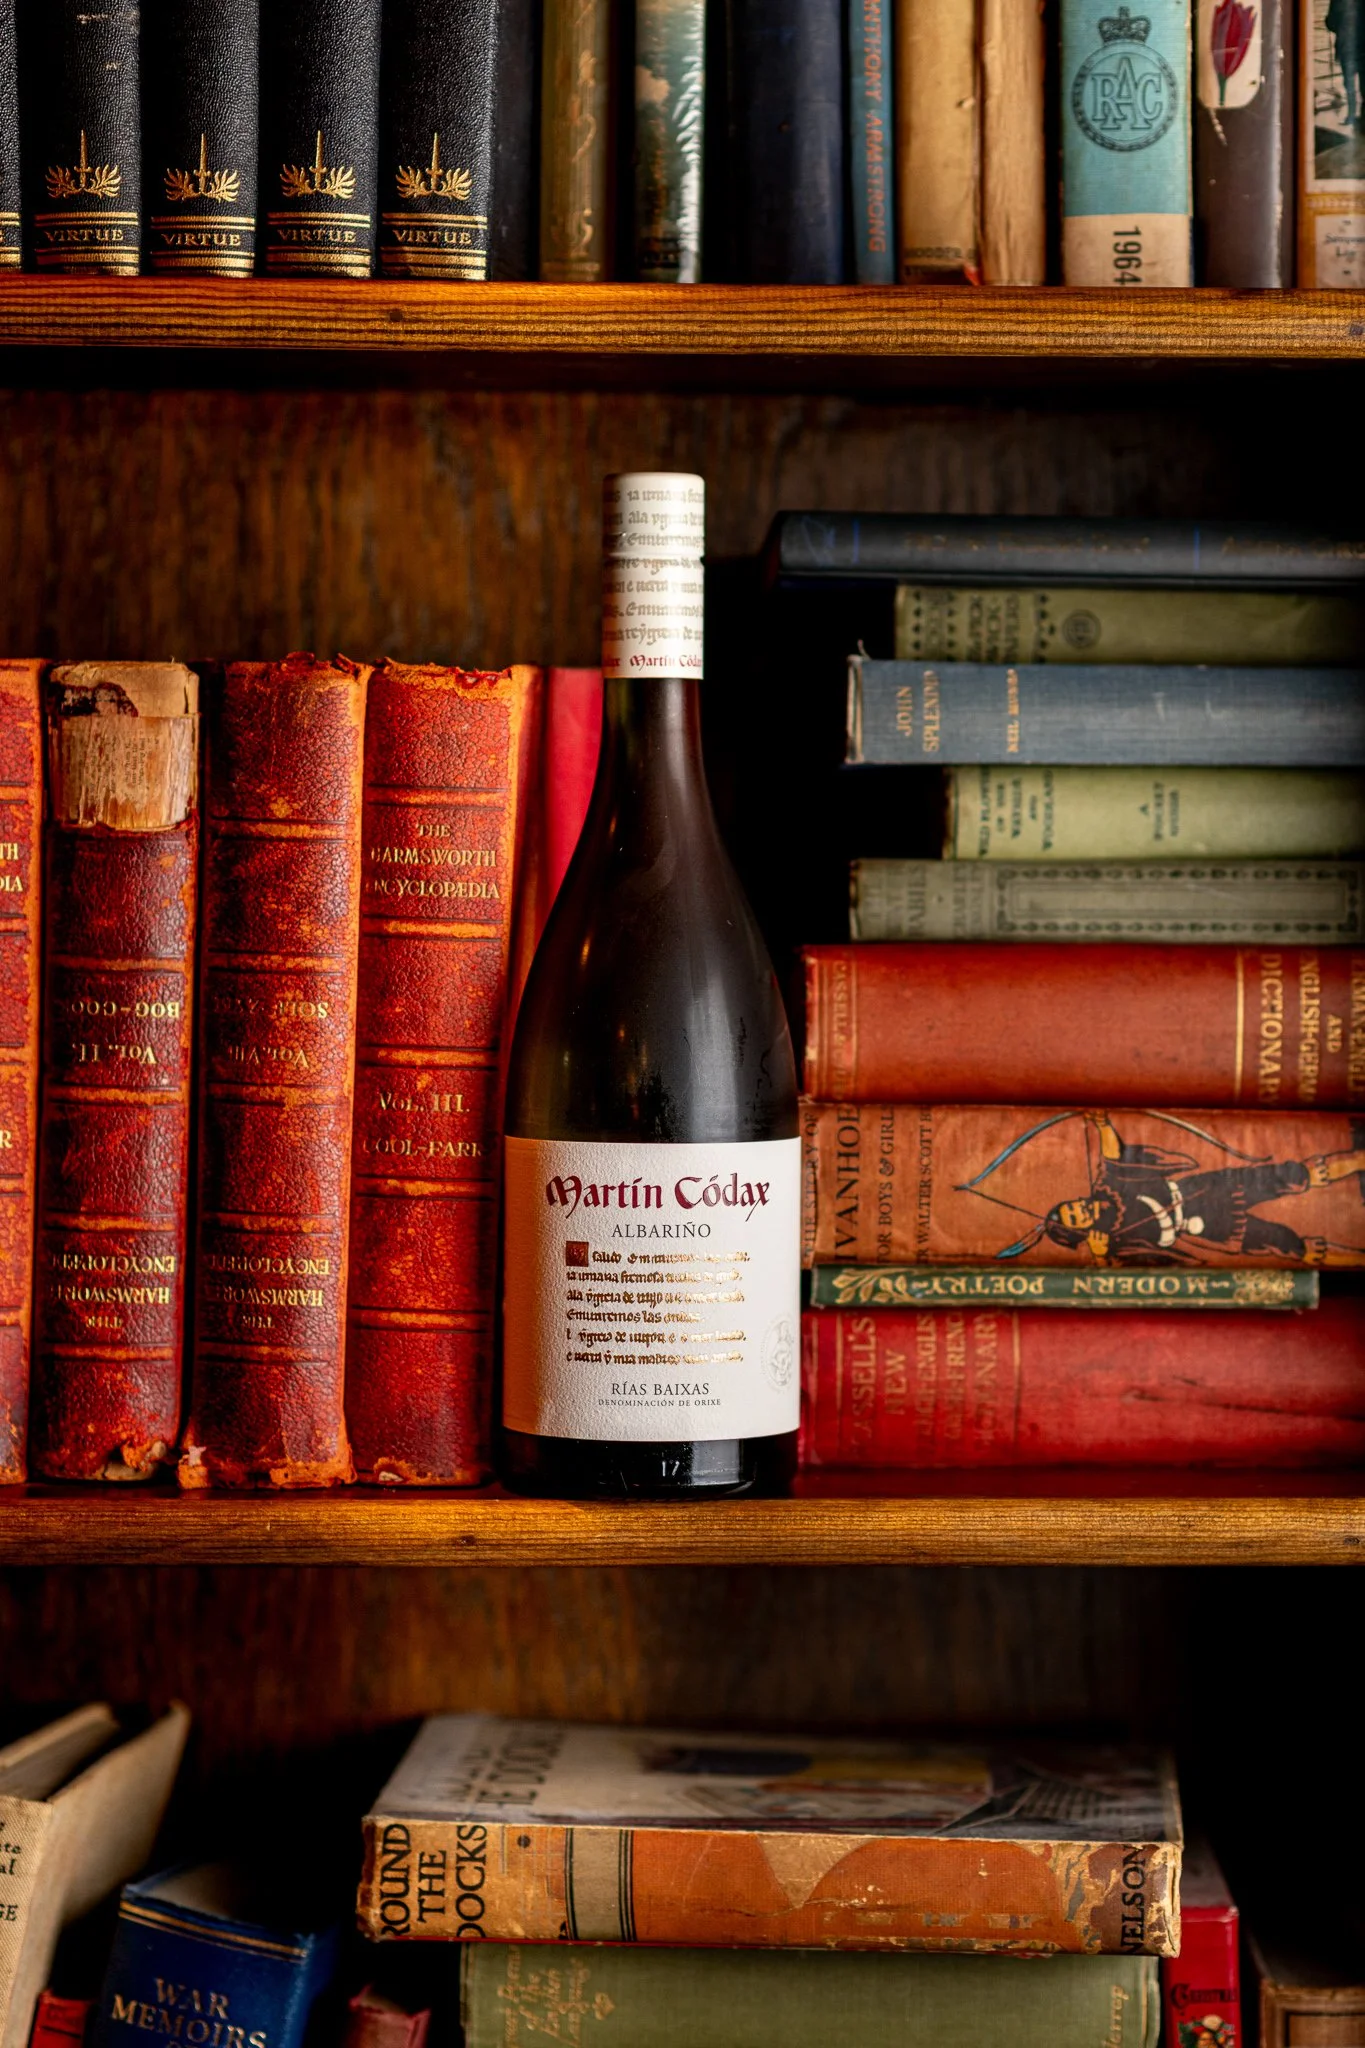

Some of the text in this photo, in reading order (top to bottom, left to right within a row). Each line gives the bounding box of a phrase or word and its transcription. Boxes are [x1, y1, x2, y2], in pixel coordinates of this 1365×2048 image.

[865, 112, 888, 253] ARMSTRONG
[46, 229, 124, 242] VIRTUE
[161, 233, 241, 246] VIRTUE
[277, 229, 356, 243] VIRTUE
[393, 229, 472, 244] VIRTUE
[1113, 226, 1142, 285] 1964
[895, 685, 914, 737] JOHN
[416, 823, 452, 838] THE
[366, 879, 500, 899] NCYCLOPÆDIA
[1258, 953, 1284, 1102] DICTIONAR
[1326, 1013, 1343, 1053] AND
[877, 1157, 895, 1177] &
[919, 1124, 932, 1176] SCOTT
[546, 1172, 770, 1222] Martín Códax
[834, 1106, 861, 1262] IVANHOE
[878, 1181, 892, 1226] BOYS
[611, 1221, 711, 1239] ALBARIÑO
[222, 1285, 324, 1306] HARMSWOR
[929, 1274, 1209, 1296] MODERN POETRY
[598, 1398, 721, 1407] DENOMINACIÓN DE ORIXE
[611, 1380, 710, 1395] RÍAS BAIXAS
[884, 1348, 908, 1415] NEW
[380, 1823, 412, 1937] ROUND
[416, 1849, 447, 1923] THE
[455, 1824, 487, 1938] DOCKS
[1120, 1844, 1145, 1954] NELSON
[154, 1976, 230, 2020] WAR
[111, 1993, 267, 2048] MEMOIRS
